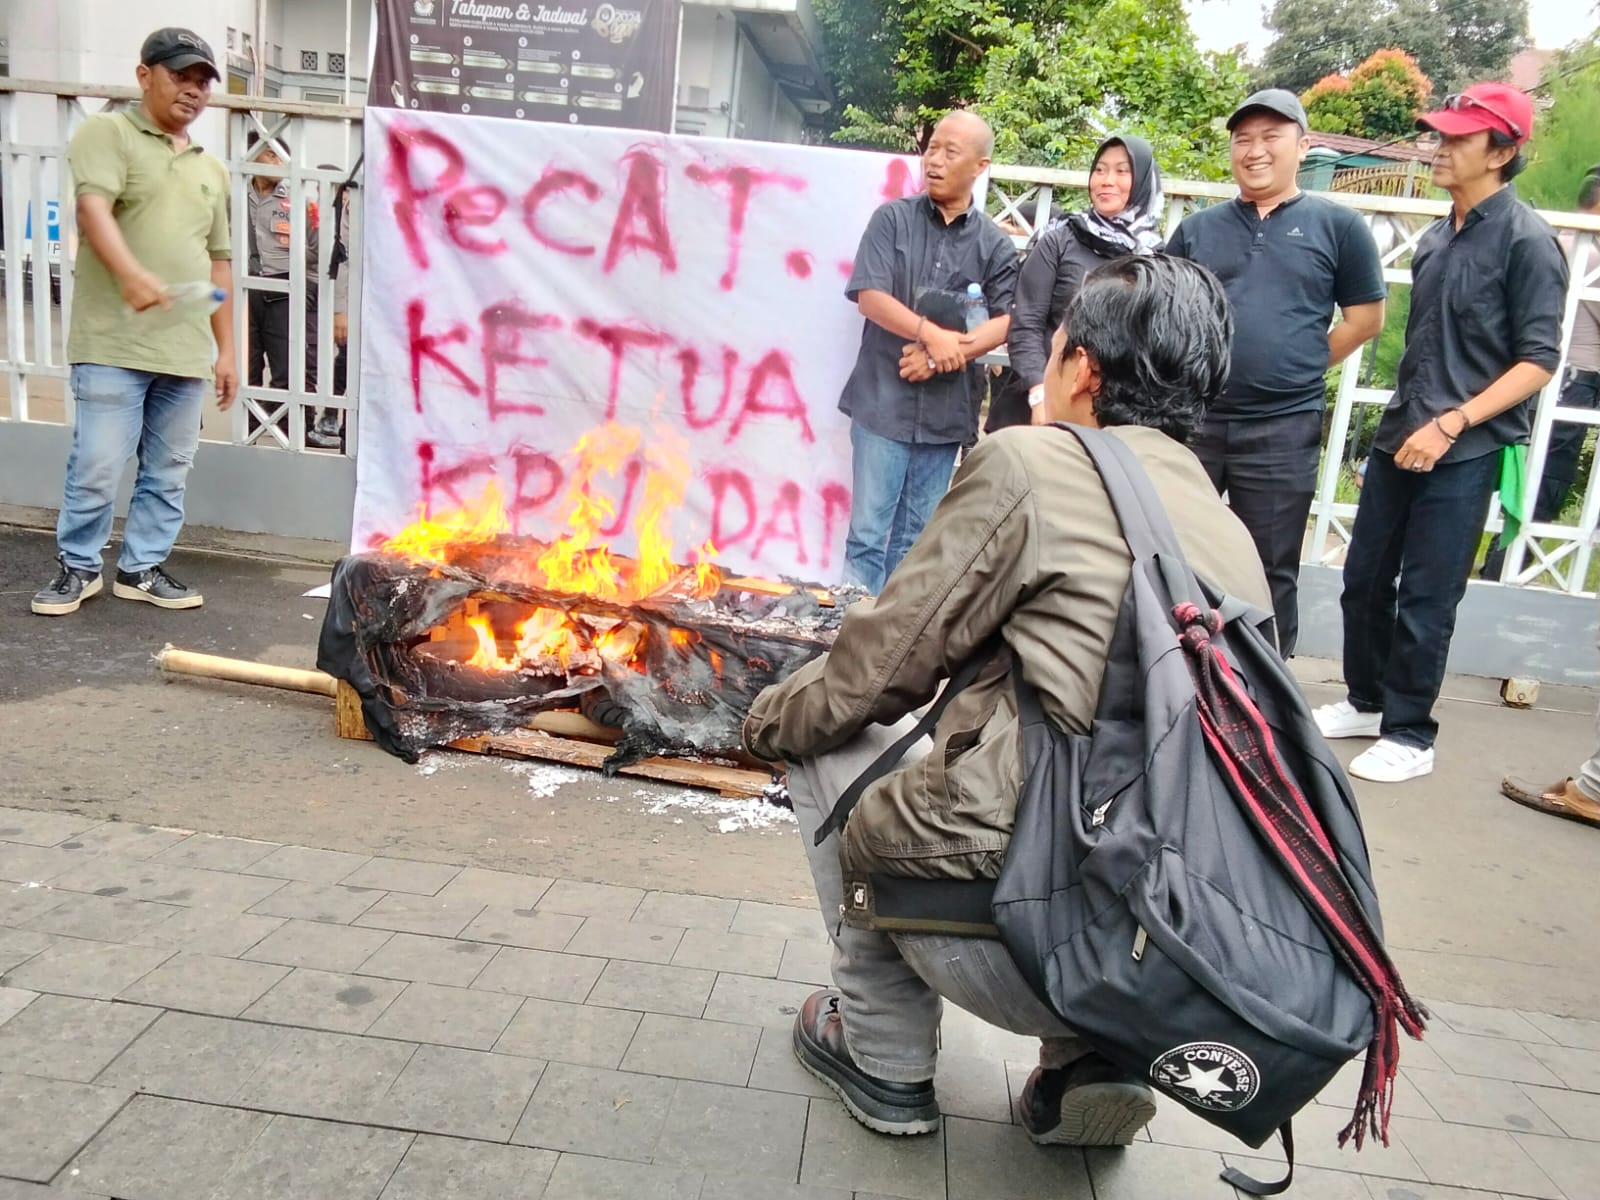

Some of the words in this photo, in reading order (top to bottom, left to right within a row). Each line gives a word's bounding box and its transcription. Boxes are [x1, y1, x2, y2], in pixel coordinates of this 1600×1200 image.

[450, 0, 513, 20] Tahapan
[515, 3, 531, 21] &
[533, 5, 588, 26] Jadwal
[404, 299, 818, 444] KETUA
[1184, 1050, 1250, 1092] CONVERSE
